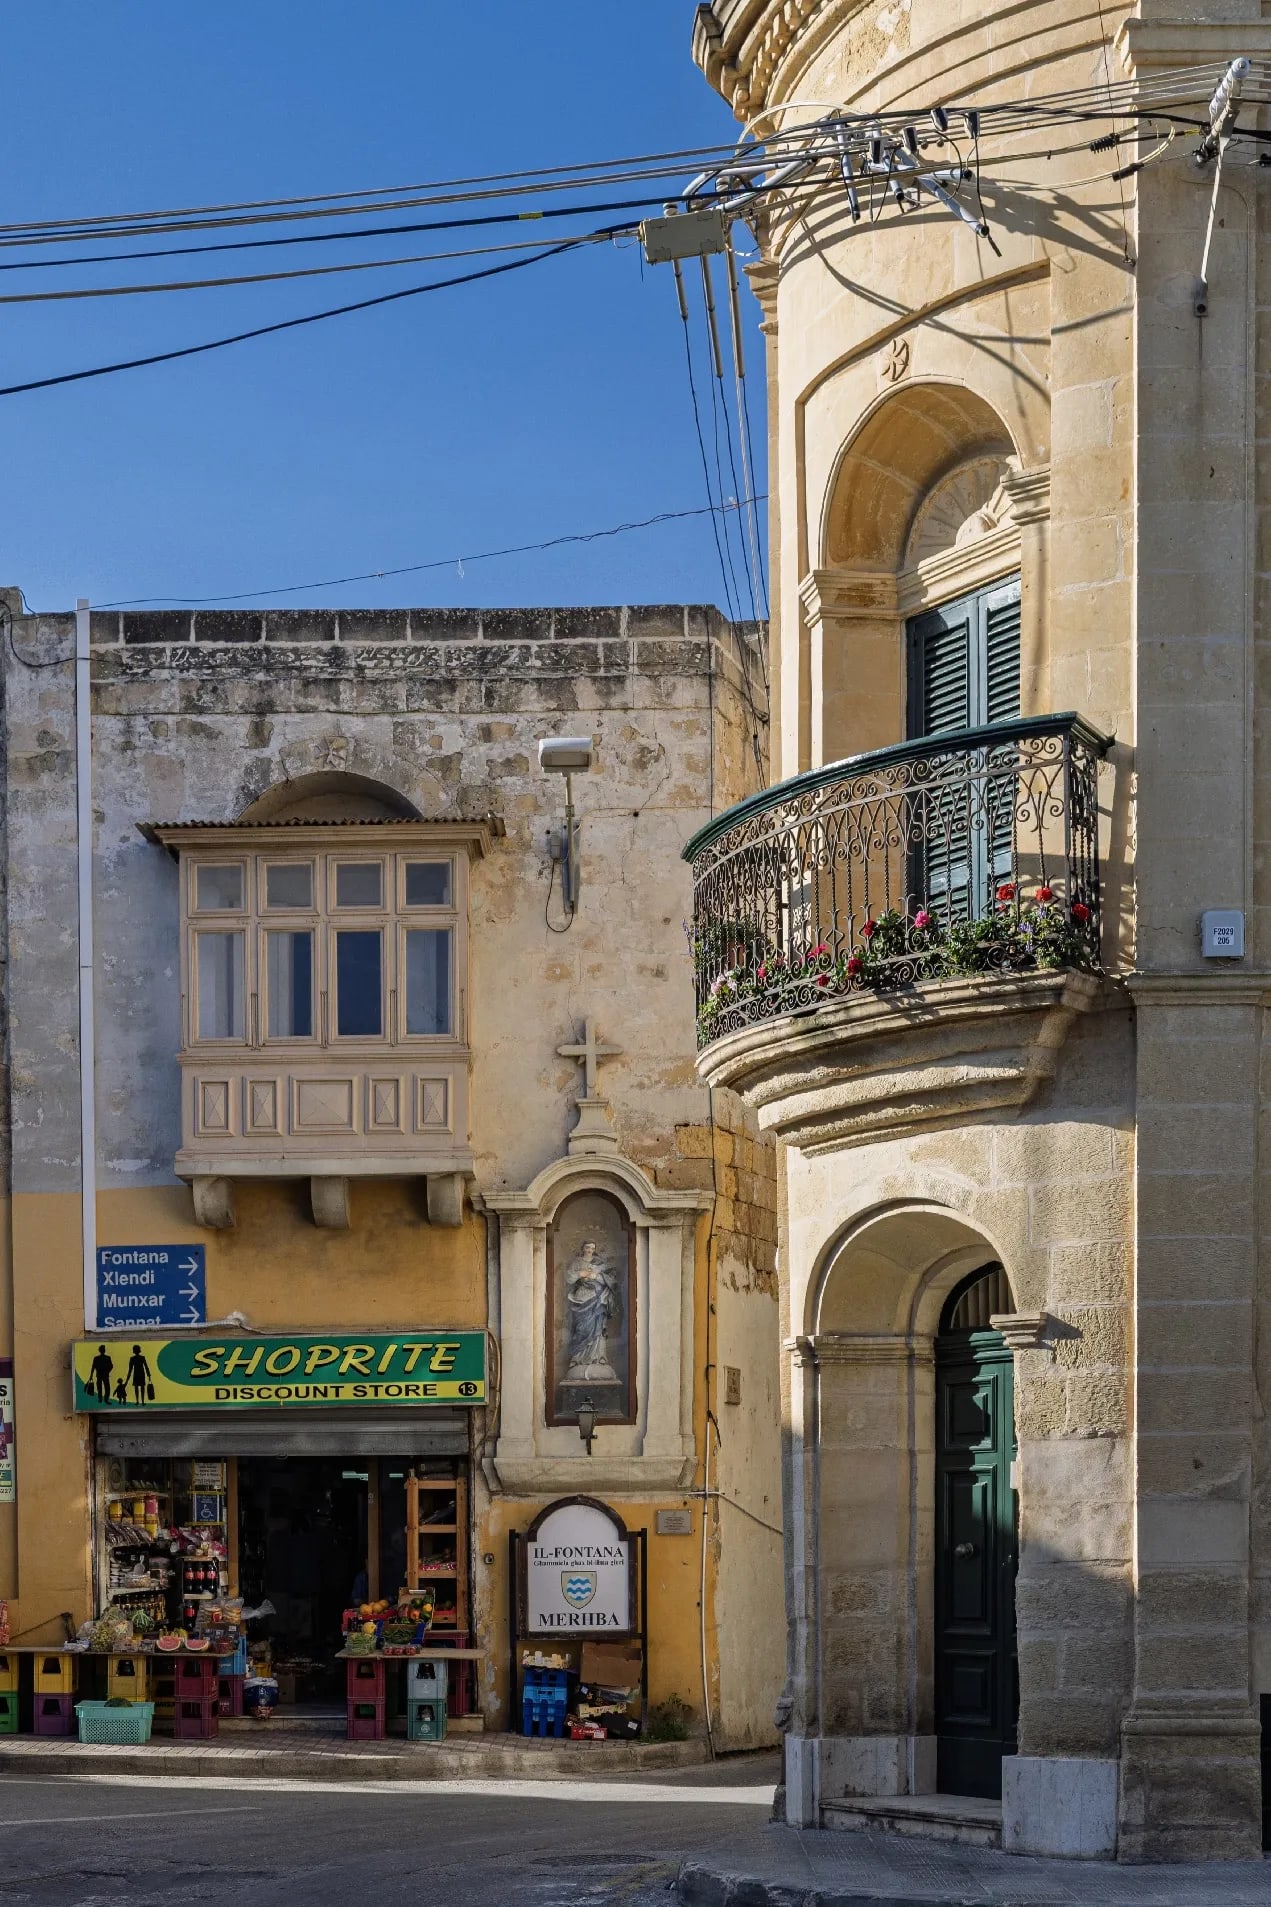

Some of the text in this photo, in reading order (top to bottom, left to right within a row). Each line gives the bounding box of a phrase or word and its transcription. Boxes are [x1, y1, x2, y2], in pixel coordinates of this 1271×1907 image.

[101, 1250, 169, 1265] Fontana
[103, 1270, 155, 1286] Xlendi
[103, 1293, 166, 1308] Munxar
[189, 1341, 462, 1378] SHOPRITE
[214, 1383, 476, 1401] DISCOUNT STORE 13
[533, 1546, 624, 1559] IL-FONTANA
